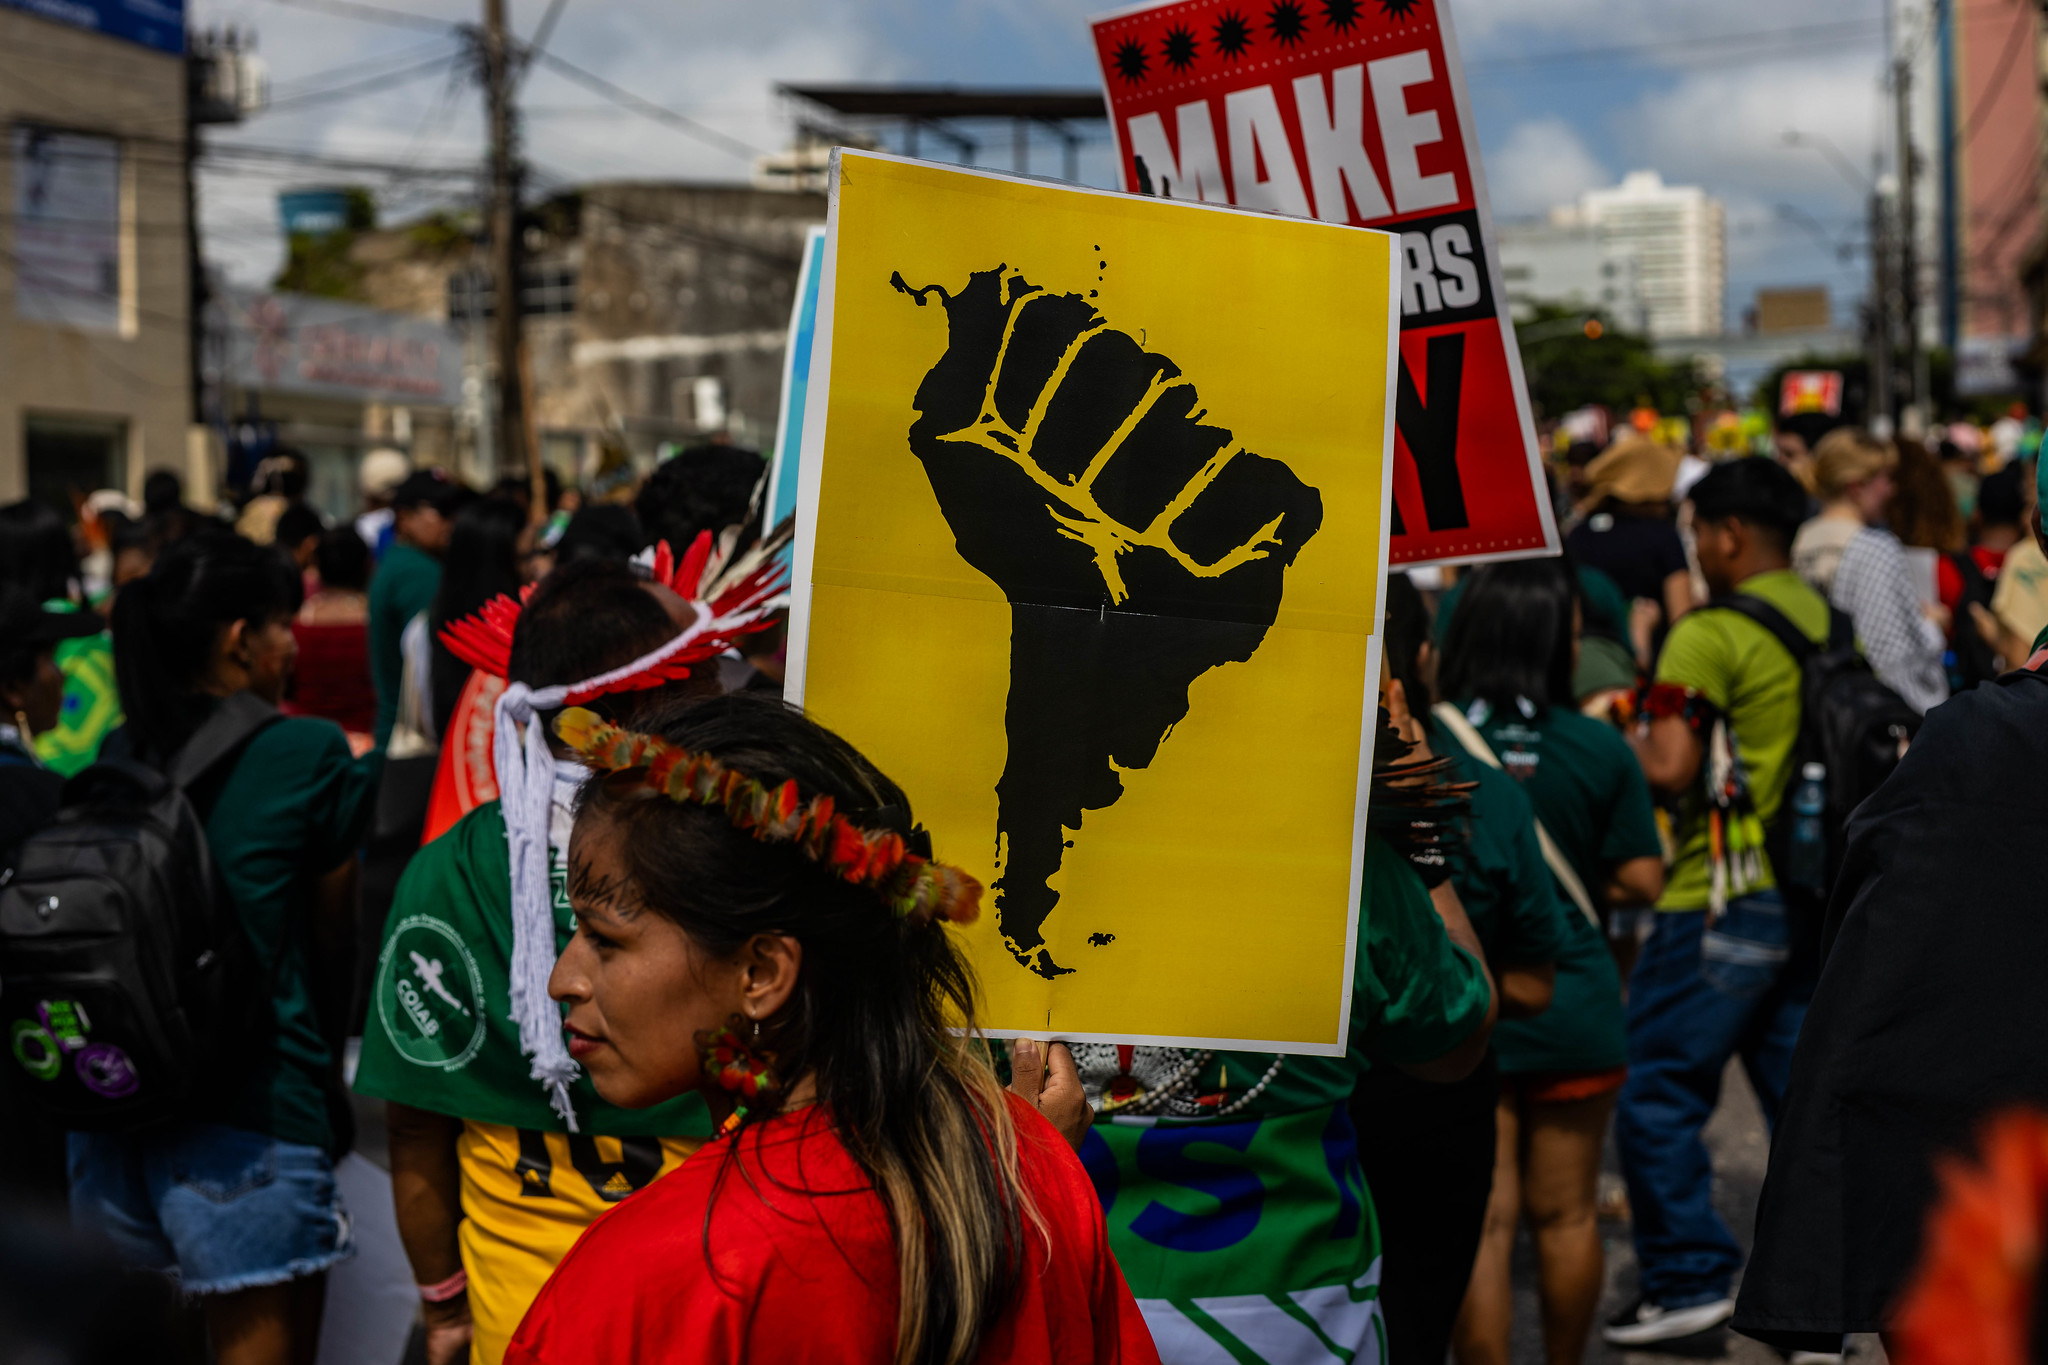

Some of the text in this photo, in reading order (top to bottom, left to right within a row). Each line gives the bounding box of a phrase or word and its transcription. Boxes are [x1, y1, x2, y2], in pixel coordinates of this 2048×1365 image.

[1126, 48, 1460, 225] MAKE
[1391, 332, 1470, 536] Y
[397, 979, 439, 1036] COIAB
